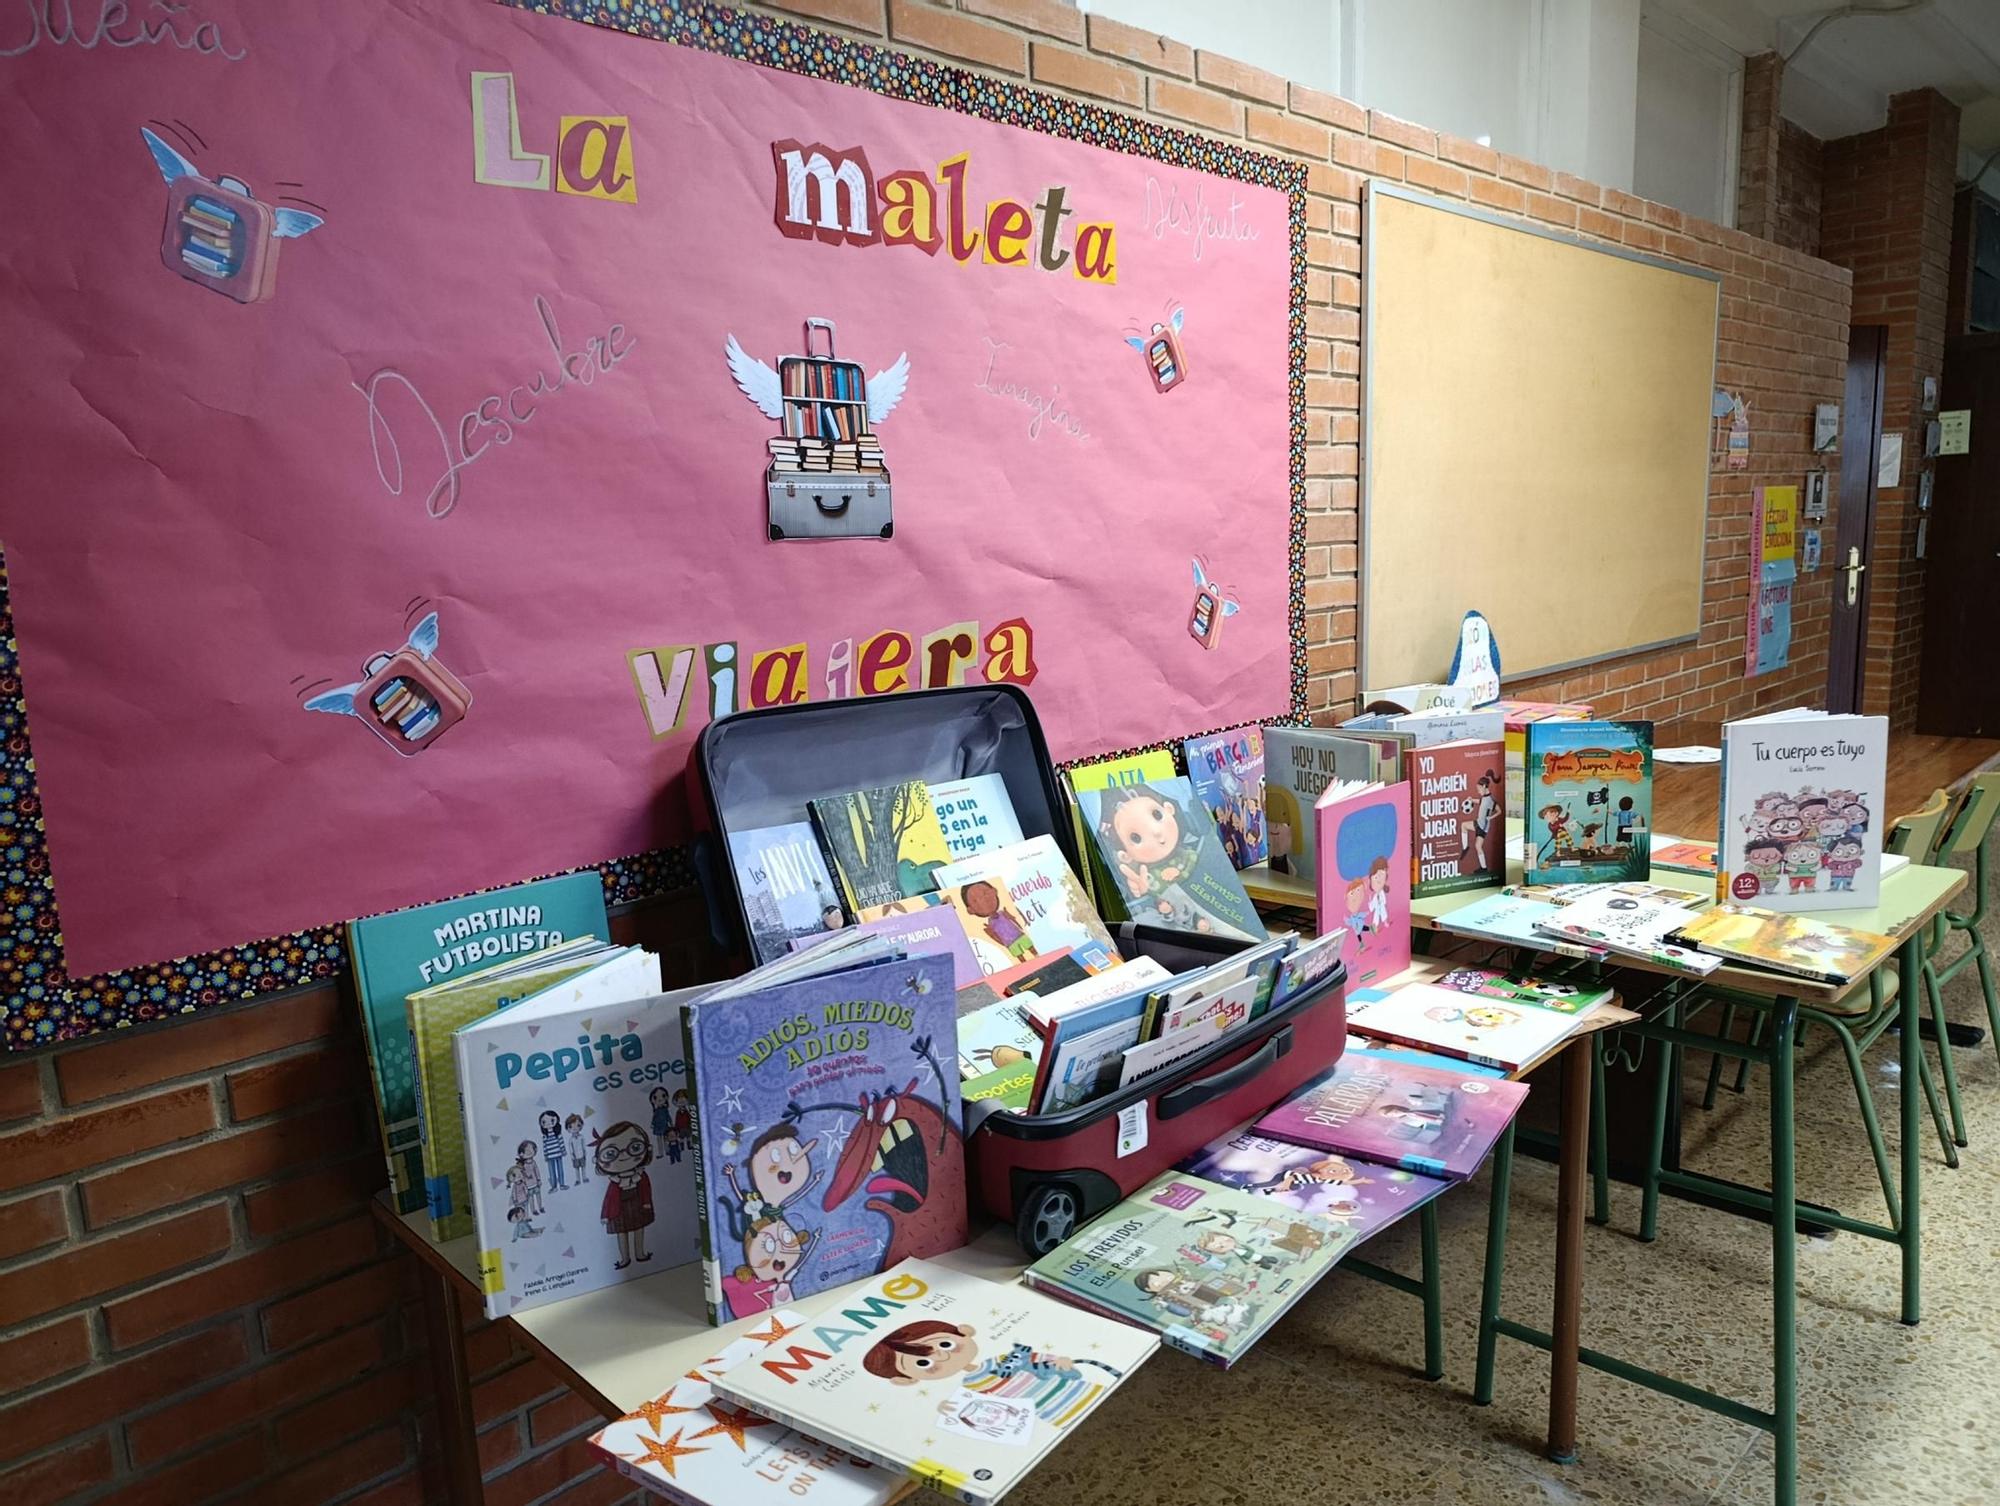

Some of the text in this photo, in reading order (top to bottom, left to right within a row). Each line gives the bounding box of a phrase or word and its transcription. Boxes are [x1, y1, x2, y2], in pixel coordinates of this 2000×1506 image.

[474, 74, 1116, 282] La maleta
[1144, 174, 1260, 261] Disfruta
[352, 296, 635, 517] Descubre
[1206, 739, 1249, 774] BARÇA
[1291, 745, 1336, 774] HOY NO
[1419, 756, 1435, 775] YO
[1752, 742, 1770, 761] Tu
[1775, 746, 1817, 763] cuerpo
[1820, 746, 1835, 757] es
[1420, 771, 1467, 797] TAMBIÉN
[937, 798, 978, 820] go un
[940, 811, 989, 836] o en la
[1420, 796, 1459, 820] QUIERO
[946, 833, 987, 853] rriga
[1420, 817, 1457, 840] JUGAR
[1421, 843, 1436, 861] AL
[1009, 869, 1053, 902] cuerdo
[1421, 860, 1461, 882] FÚTBOL
[432, 904, 543, 948] MARTINA
[418, 930, 565, 984] FUTBOLISTA
[737, 1001, 915, 1074] ADIÓS, MIEDOS,
[785, 1026, 870, 1072] ADIÓS
[592, 1057, 687, 1093] es espe
[968, 1071, 1034, 1102] sportes
[1304, 1069, 1393, 1128] PALABRAS
[1063, 1258, 1091, 1277] LOS
[1088, 1219, 1145, 1262] ATREVIDOS
[1090, 1245, 1148, 1288] Elsa Punset
[788, 1474, 819, 1498] ON
